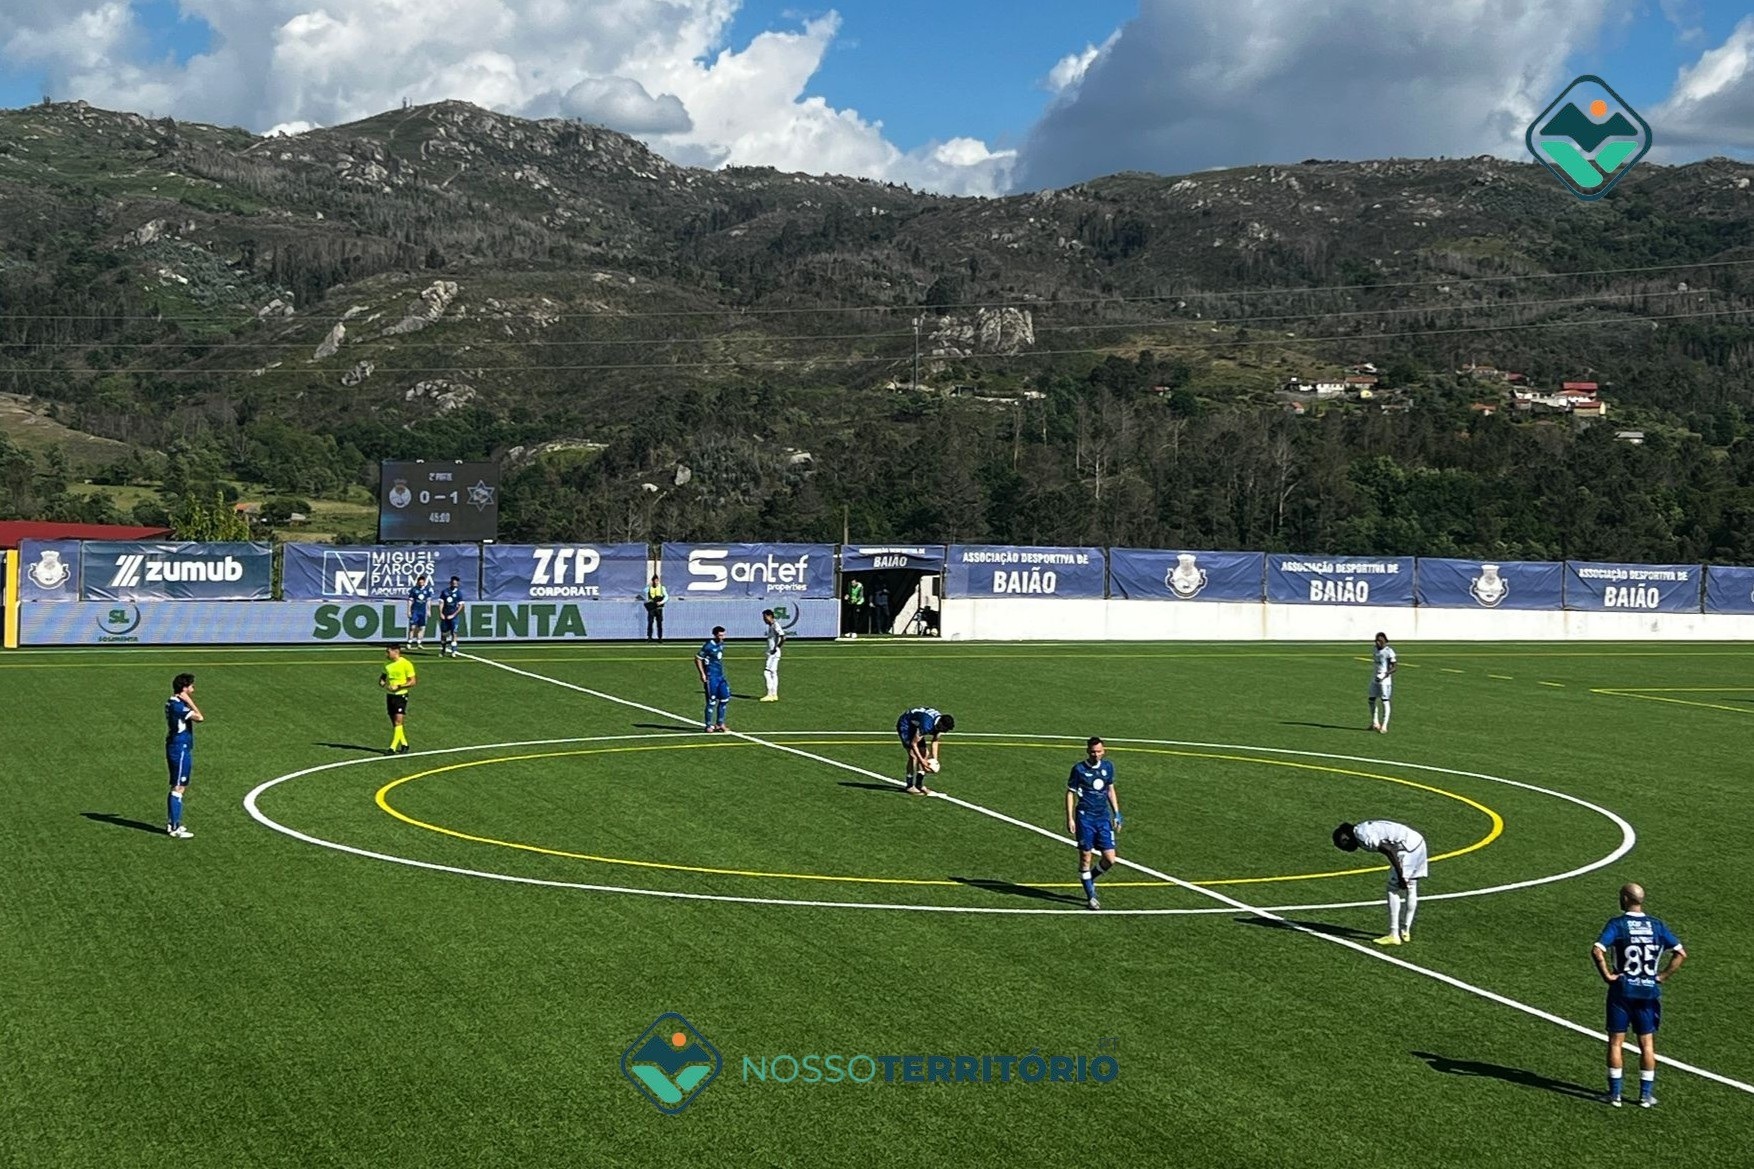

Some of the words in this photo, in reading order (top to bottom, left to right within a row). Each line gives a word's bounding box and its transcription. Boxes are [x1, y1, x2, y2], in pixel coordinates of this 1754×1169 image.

[419, 490, 430, 504] 0
[450, 490, 458, 504] 1
[372, 551, 435, 564] MIGUEL
[962, 551, 1018, 565] ASSOCIAÇÃO
[1021, 552, 1075, 564] DESPORTIVA
[1076, 554, 1089, 565] DE
[145, 556, 243, 582] zumub
[371, 562, 435, 576] ZARCOS
[530, 548, 600, 584] ZFP
[687, 549, 809, 591] Santef
[1281, 560, 1334, 575] ASSOCIAÇÃO
[1336, 563, 1385, 573] DESPORTIVA
[1387, 563, 1399, 573] DE
[993, 566, 1057, 593] BAIÃO
[1579, 567, 1627, 582] ASSOCIAÇÃO
[1629, 569, 1676, 581] DESPORTIVA
[1677, 571, 1689, 581] DE
[529, 586, 599, 597] CORPORATE
[767, 583, 807, 593] properties
[1310, 576, 1369, 603] BAIÃO
[1604, 583, 1660, 609] BAIÃO
[108, 609, 130, 624] SL
[312, 604, 587, 639] SOLMENTA
[1624, 944, 1660, 976] 85
